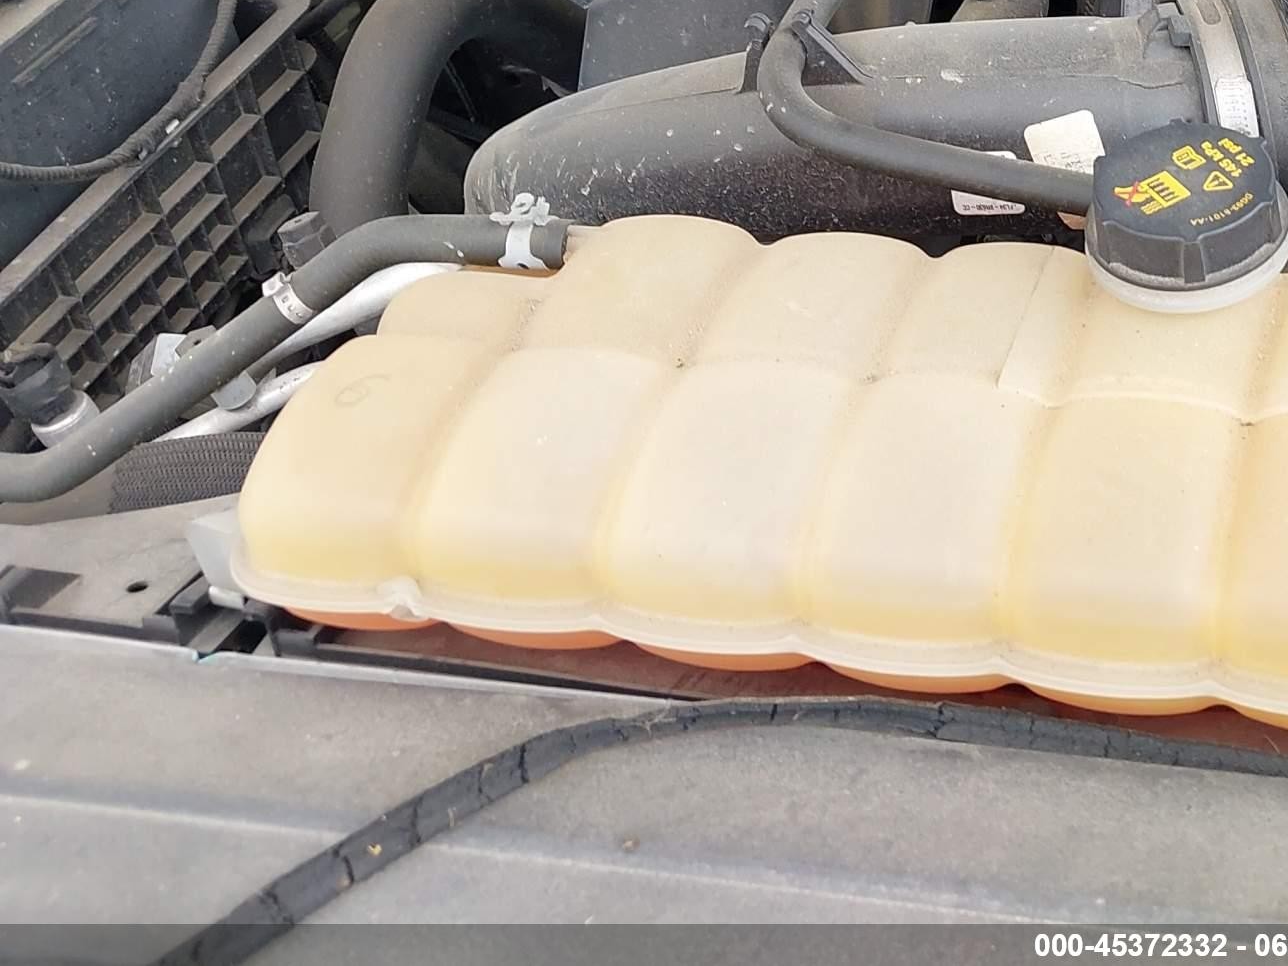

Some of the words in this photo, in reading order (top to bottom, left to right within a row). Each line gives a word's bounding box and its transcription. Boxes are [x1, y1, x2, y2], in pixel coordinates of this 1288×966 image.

[1201, 141, 1224, 161] kPa
[1218, 138, 1242, 154] psi
[1219, 158, 1242, 177] 145
[1235, 152, 1255, 166] 21
